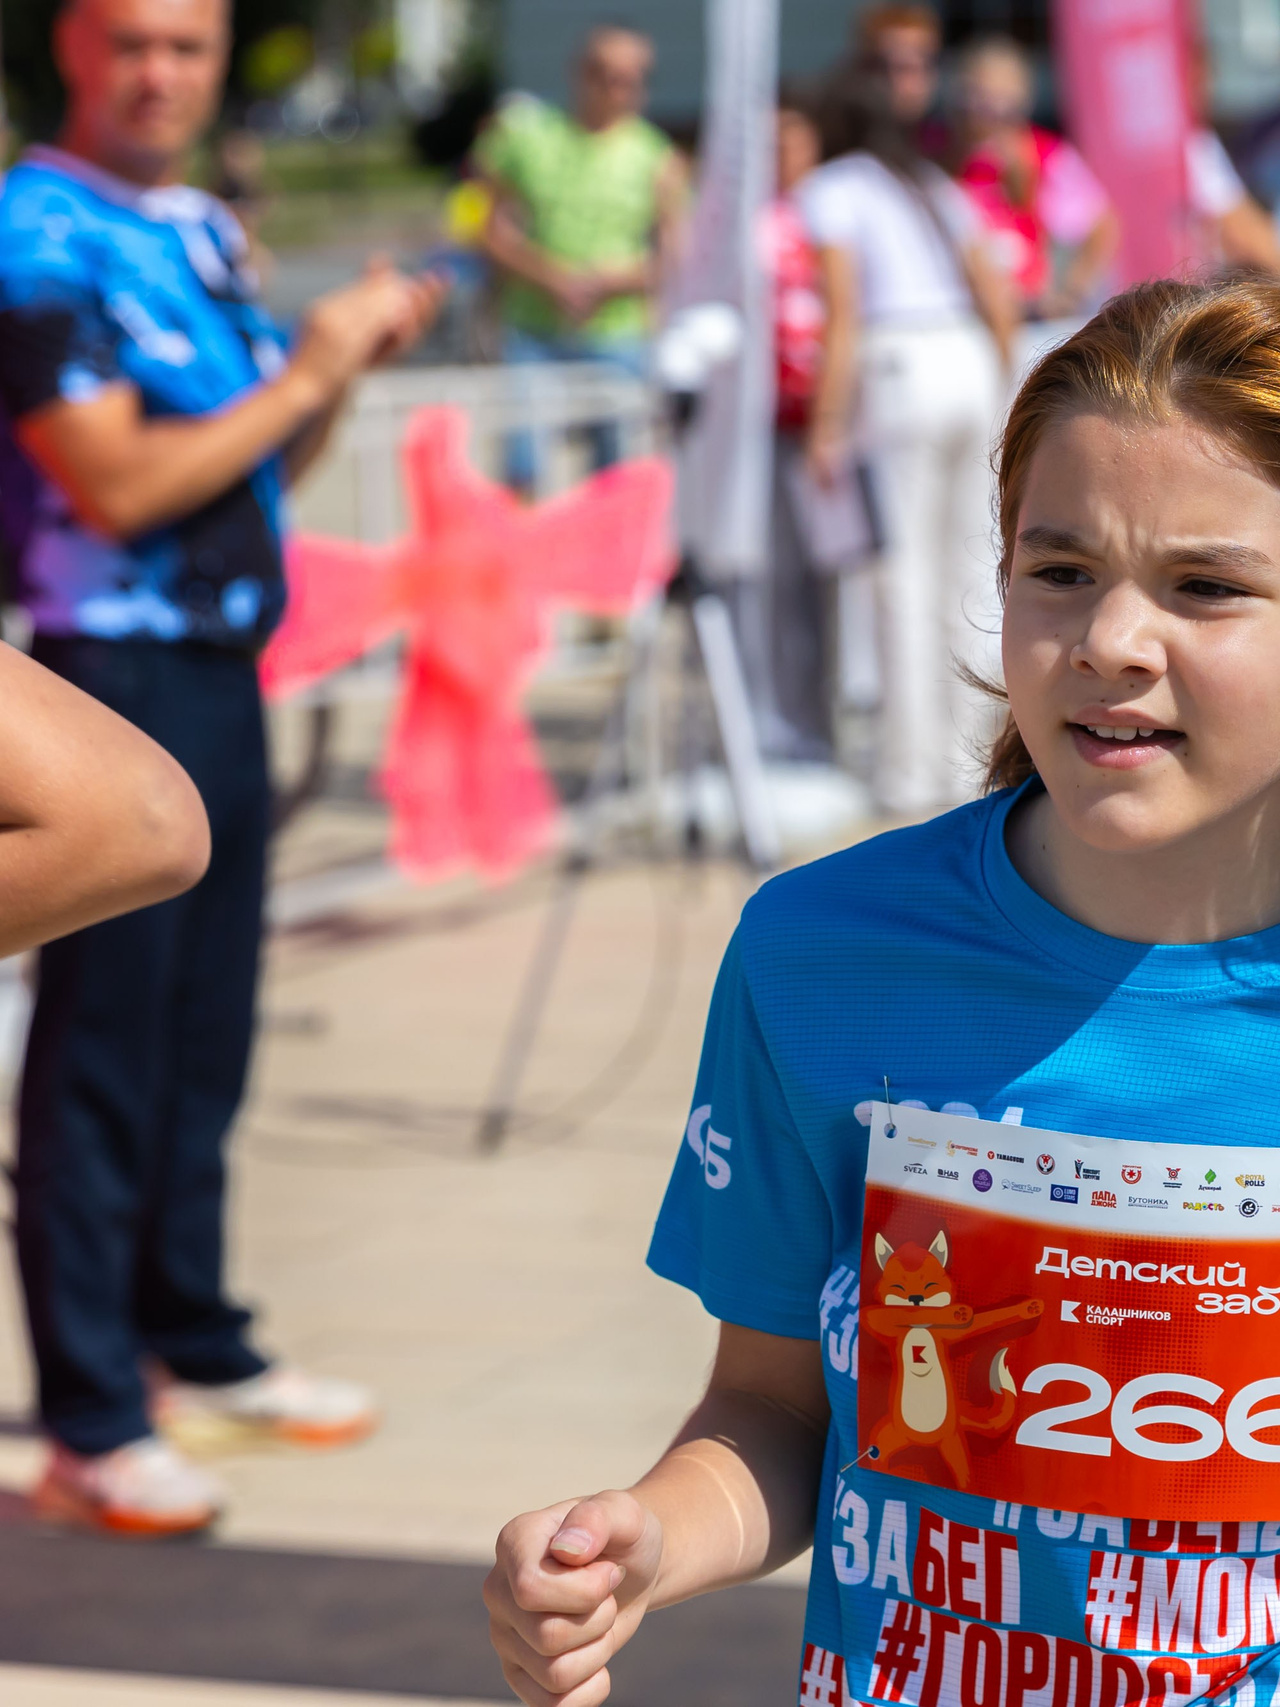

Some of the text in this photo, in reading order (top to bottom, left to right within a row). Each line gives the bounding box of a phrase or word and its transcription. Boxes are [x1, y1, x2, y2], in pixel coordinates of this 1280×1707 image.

[903, 1165, 928, 1175] SVEZA
[1091, 1190, 1117, 1201] ПАПА
[1128, 1196, 1169, 1205] БУТОНИКА
[1091, 1200, 1117, 1208] ДЖОНС
[1183, 1202, 1225, 1211] РАДОСТЬ
[1035, 1246, 1246, 1287] Детский
[1086, 1304, 1171, 1321] КАЛАШНИКОВ
[1086, 1314, 1124, 1327] СПОРТ
[832, 1474, 1020, 1625] ЗАБЕГ
